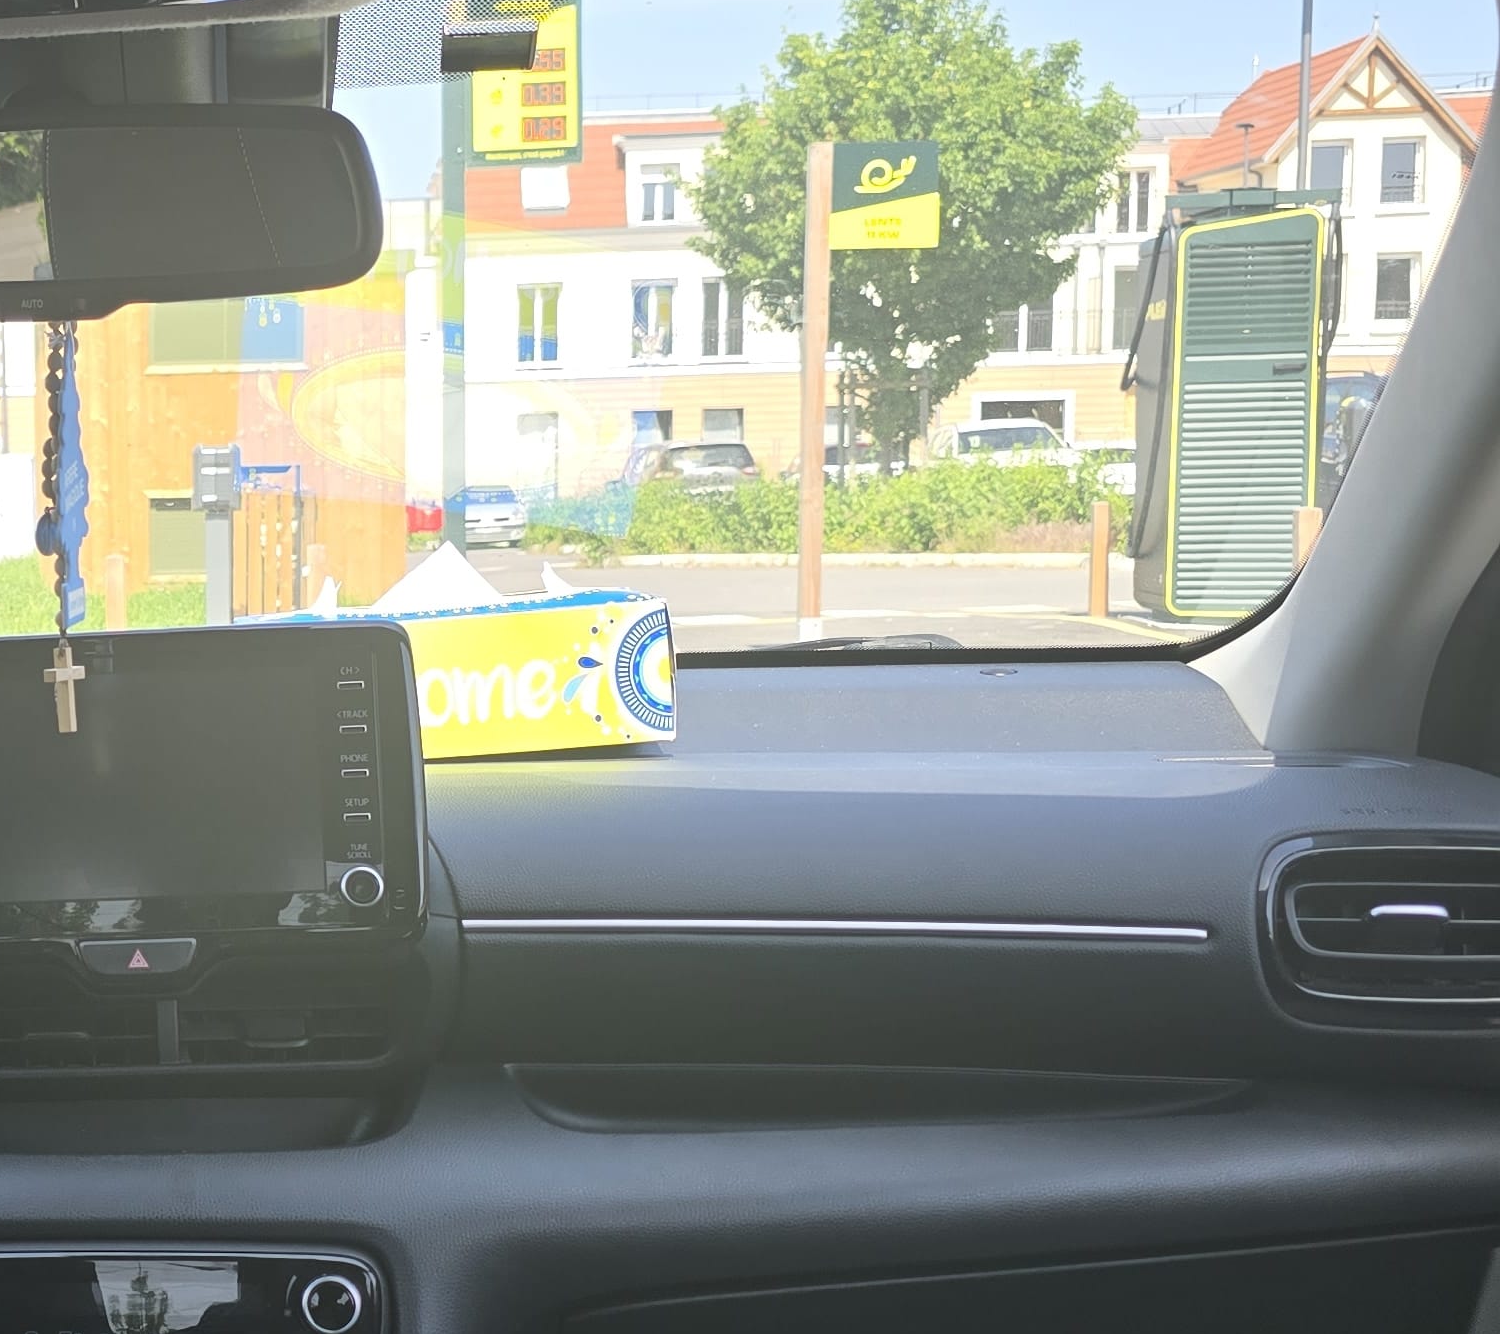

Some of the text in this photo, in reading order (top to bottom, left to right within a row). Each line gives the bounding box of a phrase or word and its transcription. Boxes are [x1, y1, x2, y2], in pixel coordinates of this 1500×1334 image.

[21, 298, 44, 309] AUTO
[340, 753, 369, 763] PHONE
[344, 797, 370, 808] SETUP
